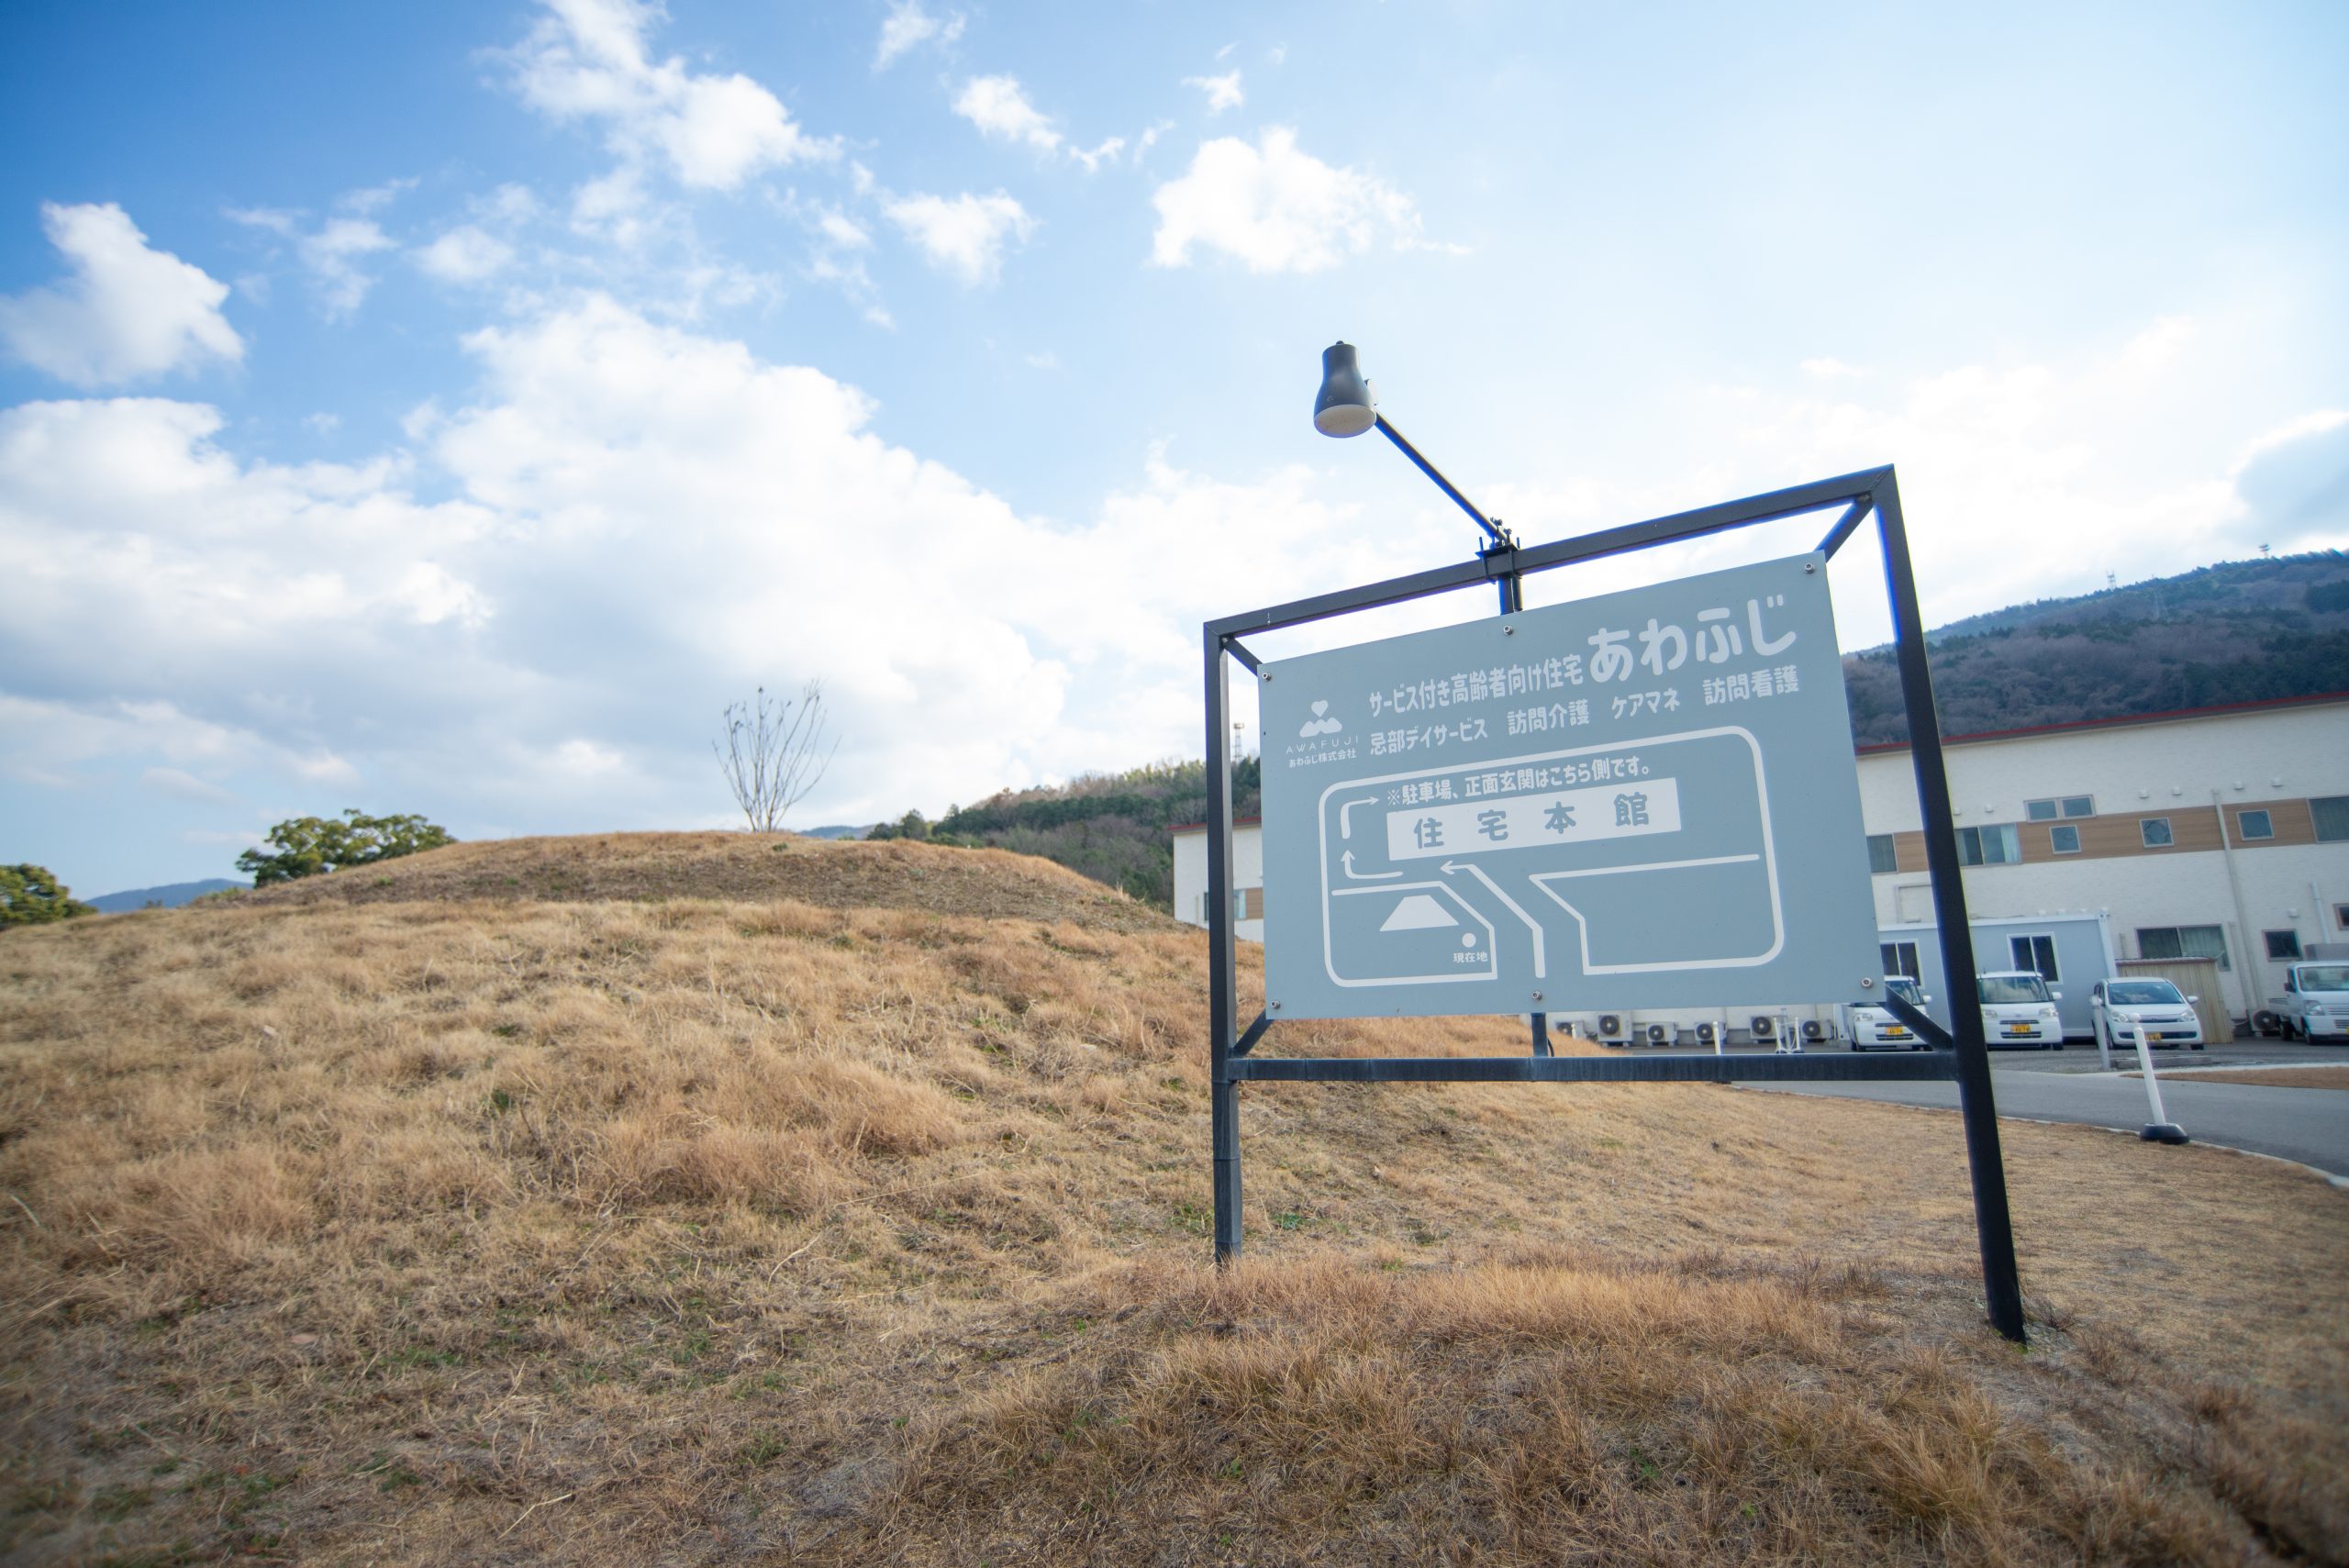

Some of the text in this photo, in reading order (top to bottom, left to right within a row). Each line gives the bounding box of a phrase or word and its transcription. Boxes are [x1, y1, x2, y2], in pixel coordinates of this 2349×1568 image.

[1369, 595, 1797, 718] サービス付き高齢者向け住宅 あわふじ
[1370, 664, 1799, 756] 忌部デイサービス 訪問介護 ケアマネ 訪問看護
[1286, 734, 1359, 755] AWAFUJI
[1288, 748, 1357, 769] あわふじ株式会社
[1453, 951, 1488, 963] 現在地
